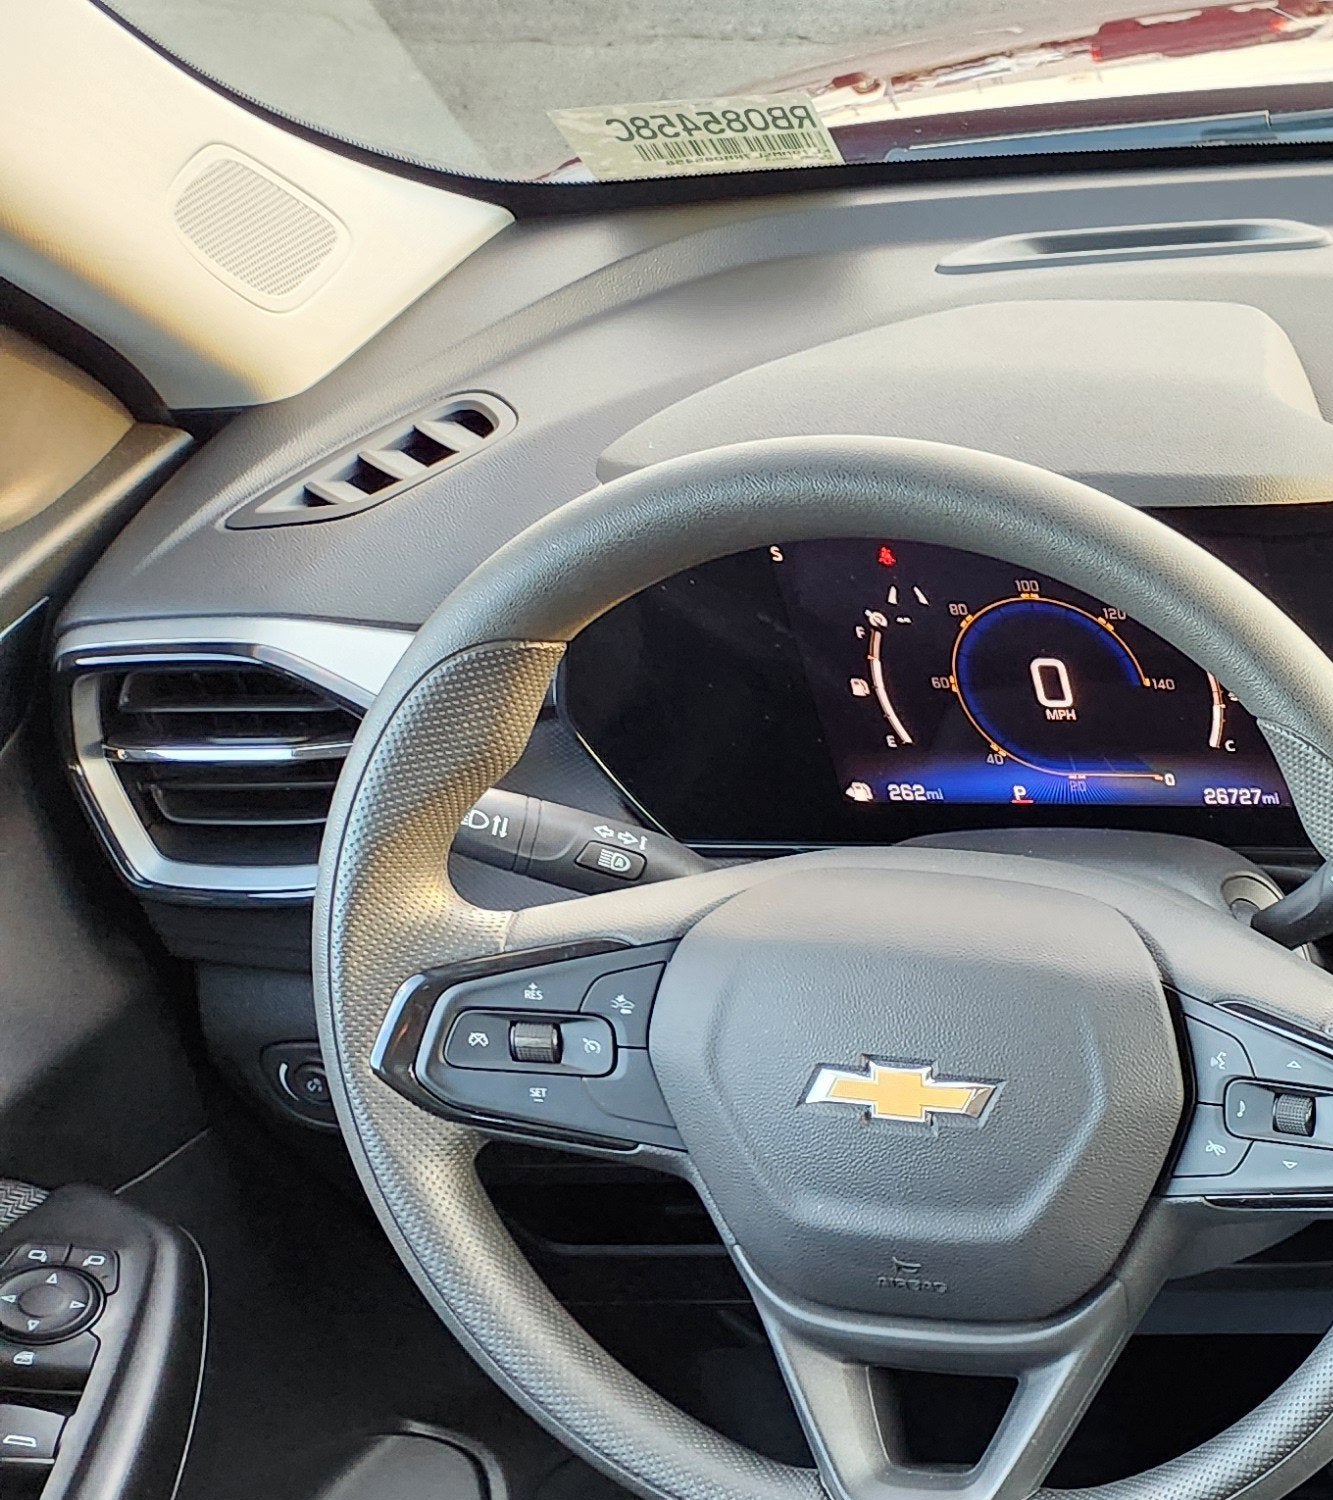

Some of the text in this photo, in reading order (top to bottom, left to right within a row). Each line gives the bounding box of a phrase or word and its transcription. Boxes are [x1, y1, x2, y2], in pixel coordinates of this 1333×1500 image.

[1015, 579, 1040, 592] 100
[948, 603, 969, 616] 80
[1102, 607, 1127, 620] 120
[931, 676, 950, 689] 60
[1030, 658, 1074, 708] 0
[1152, 678, 1175, 690] 140
[1045, 709, 1077, 721] MPH
[886, 734, 898, 748] E
[1225, 739, 1236, 752] C
[986, 753, 1004, 766] 40
[1013, 785, 1027, 801] P
[524, 989, 543, 1001] RES
[529, 1087, 548, 1098] SET
